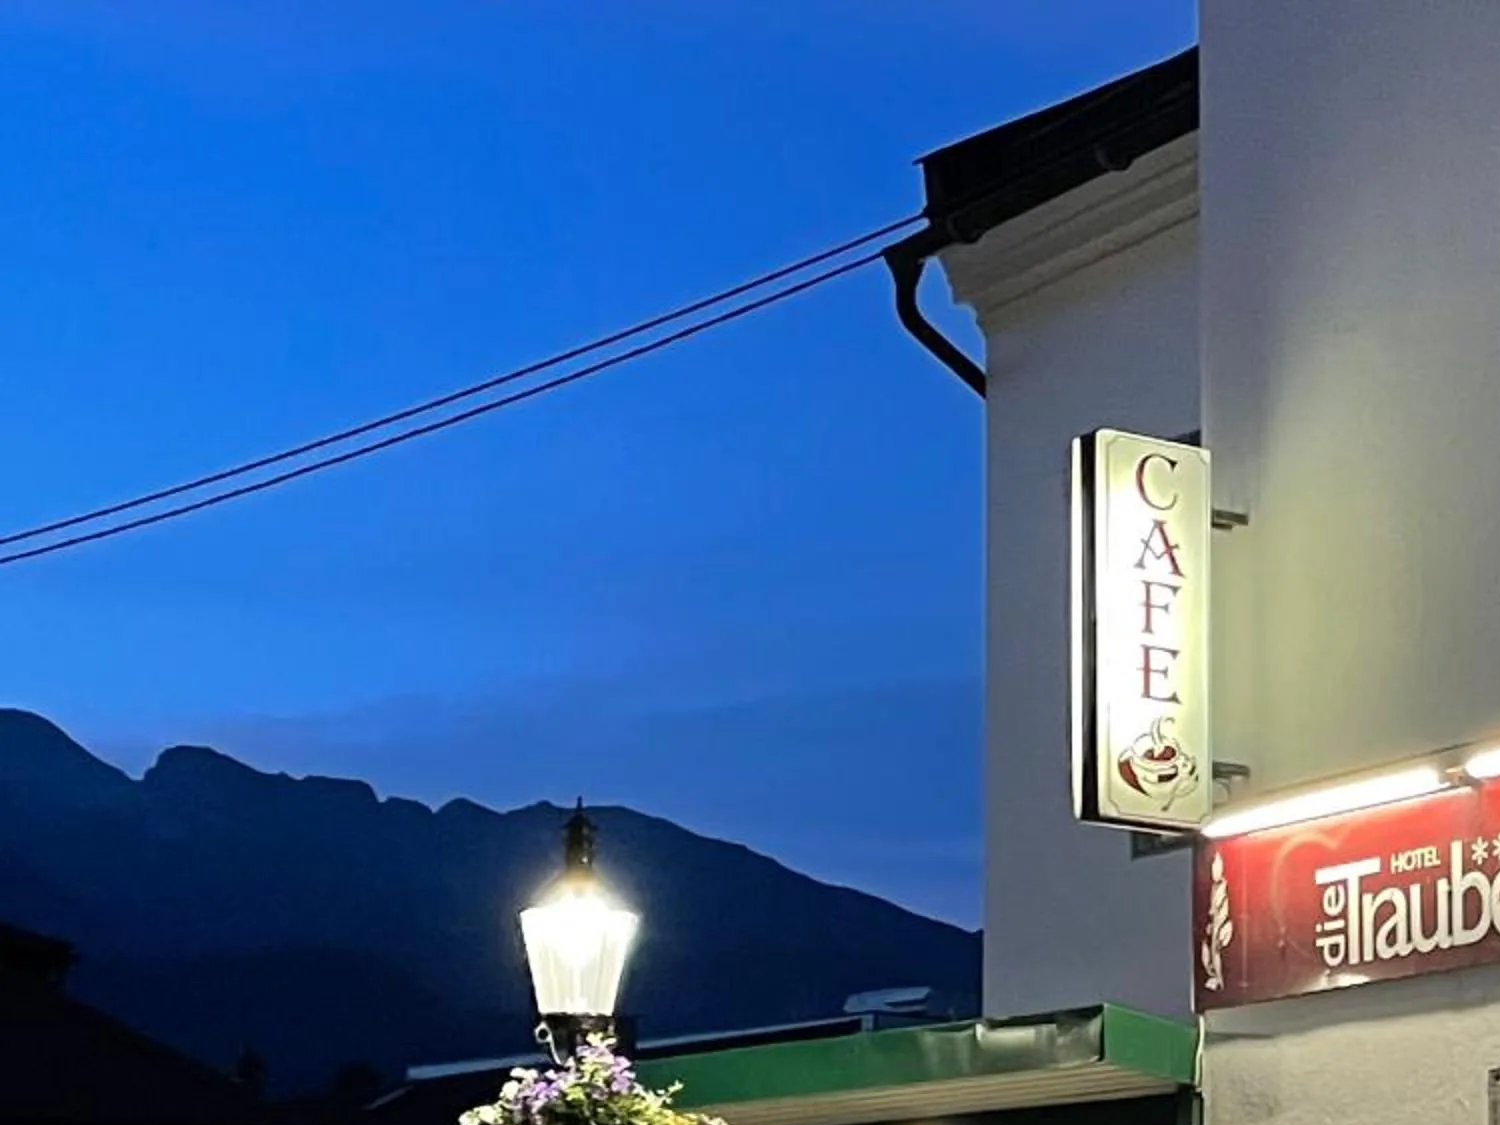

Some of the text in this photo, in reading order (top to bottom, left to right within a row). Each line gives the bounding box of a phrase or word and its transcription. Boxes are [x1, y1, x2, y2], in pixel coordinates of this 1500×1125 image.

[1134, 453, 1185, 706] CAFE
[1391, 846, 1441, 873] HOTEL
[1316, 884, 1346, 966] die
